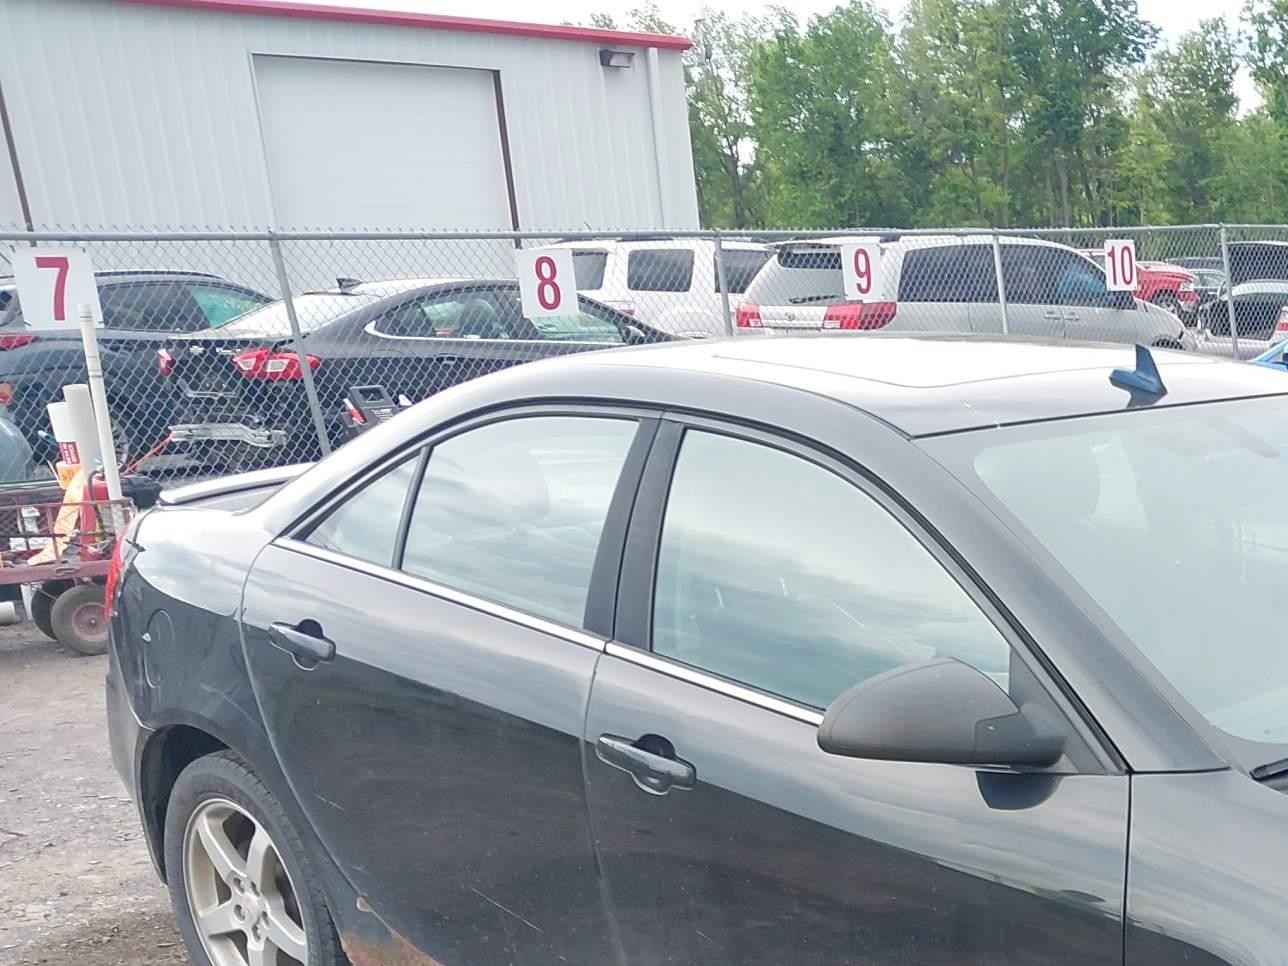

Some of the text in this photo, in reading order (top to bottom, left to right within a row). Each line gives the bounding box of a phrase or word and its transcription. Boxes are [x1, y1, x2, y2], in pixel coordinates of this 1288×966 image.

[34, 256, 69, 321] 7
[535, 255, 561, 310] 8
[853, 248, 872, 295] 9
[1107, 245, 1134, 286] 10
